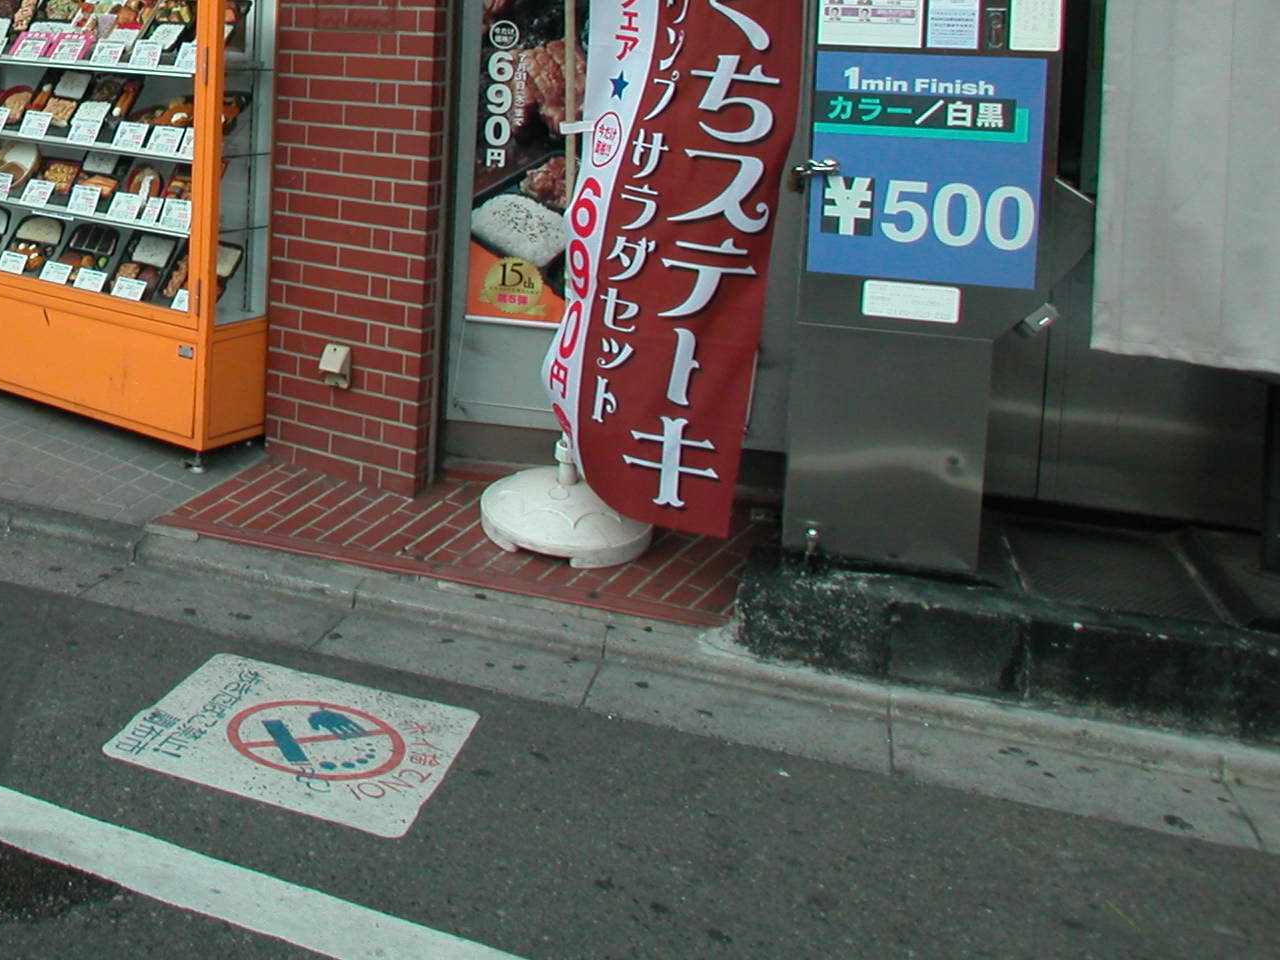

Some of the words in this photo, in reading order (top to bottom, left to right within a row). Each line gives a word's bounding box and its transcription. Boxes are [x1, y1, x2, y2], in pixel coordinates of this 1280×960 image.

[484, 50, 515, 168] 690円
[843, 67, 908, 92] 1min
[914, 78, 995, 96] Finish
[823, 175, 1036, 251] ¥500
[549, 176, 602, 400] 690円
[152, 668, 264, 760] 歩きたばこ禁止!
